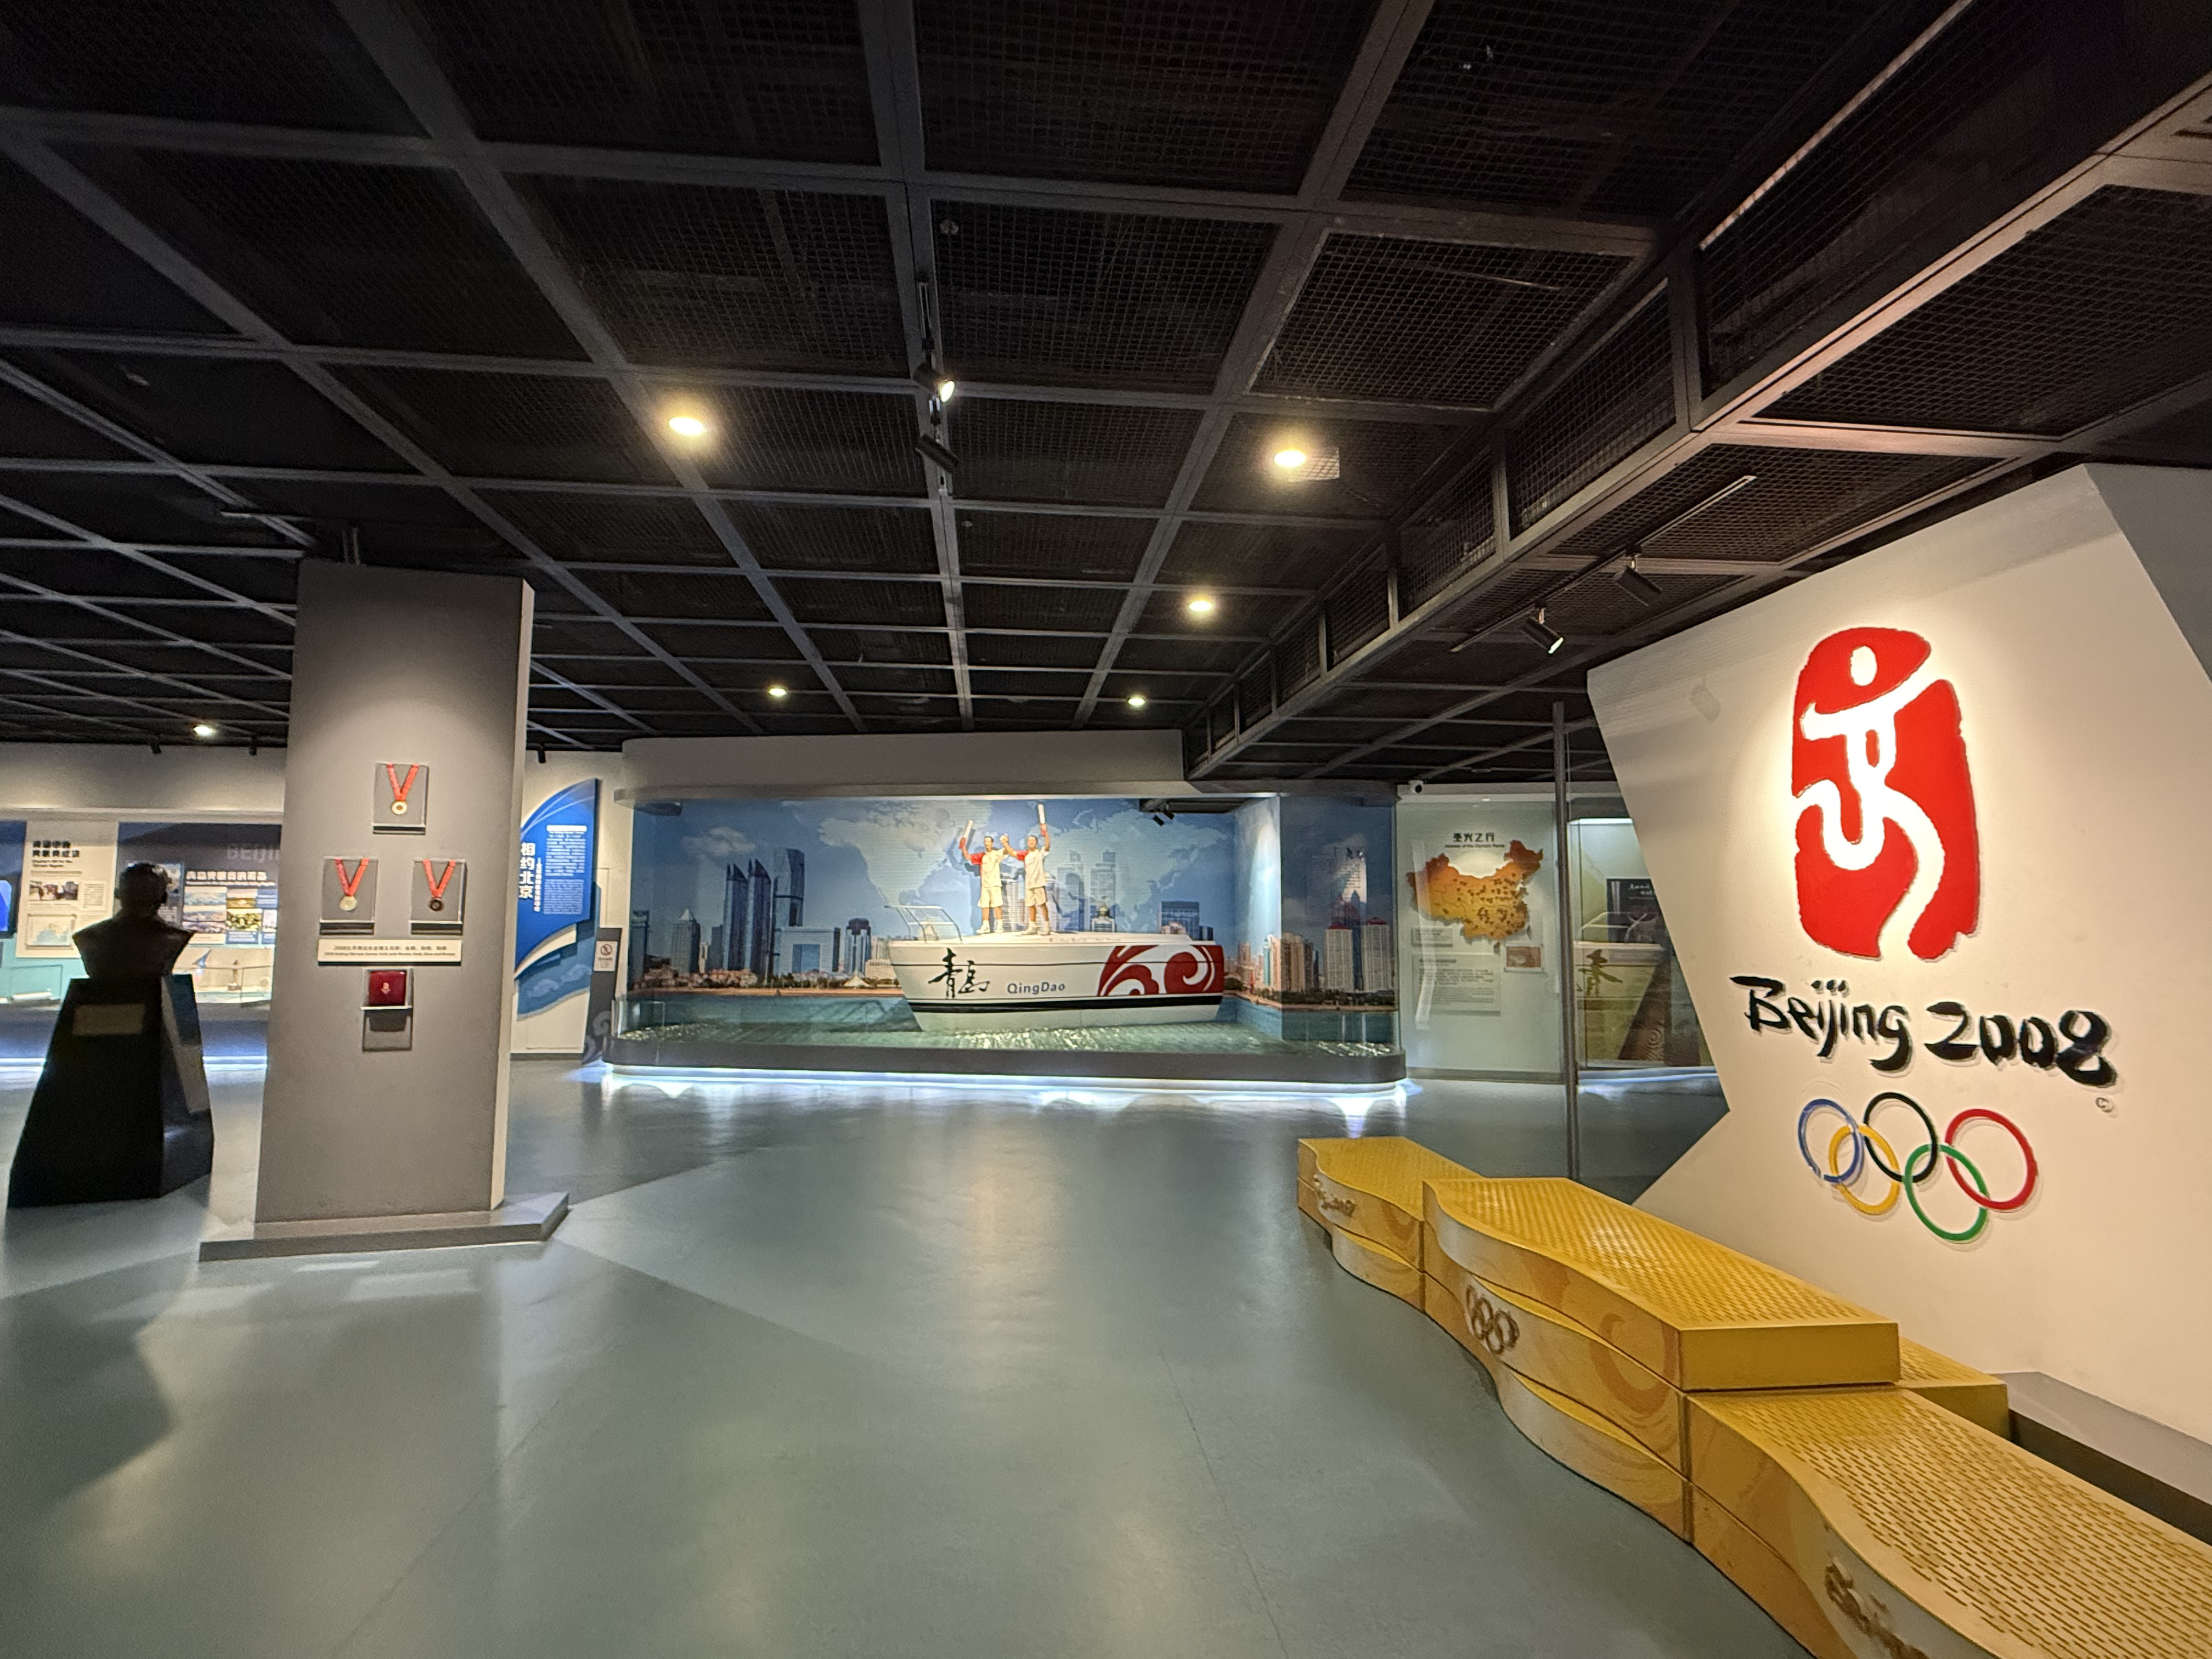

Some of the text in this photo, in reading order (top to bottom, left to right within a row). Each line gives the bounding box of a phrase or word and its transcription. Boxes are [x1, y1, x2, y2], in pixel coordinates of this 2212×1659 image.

[1453, 833, 1494, 842] 圣火之行
[519, 842, 535, 899] 相约北京
[1007, 982, 1065, 995] QingDao
[1730, 977, 2117, 1086] Beijing 2008
